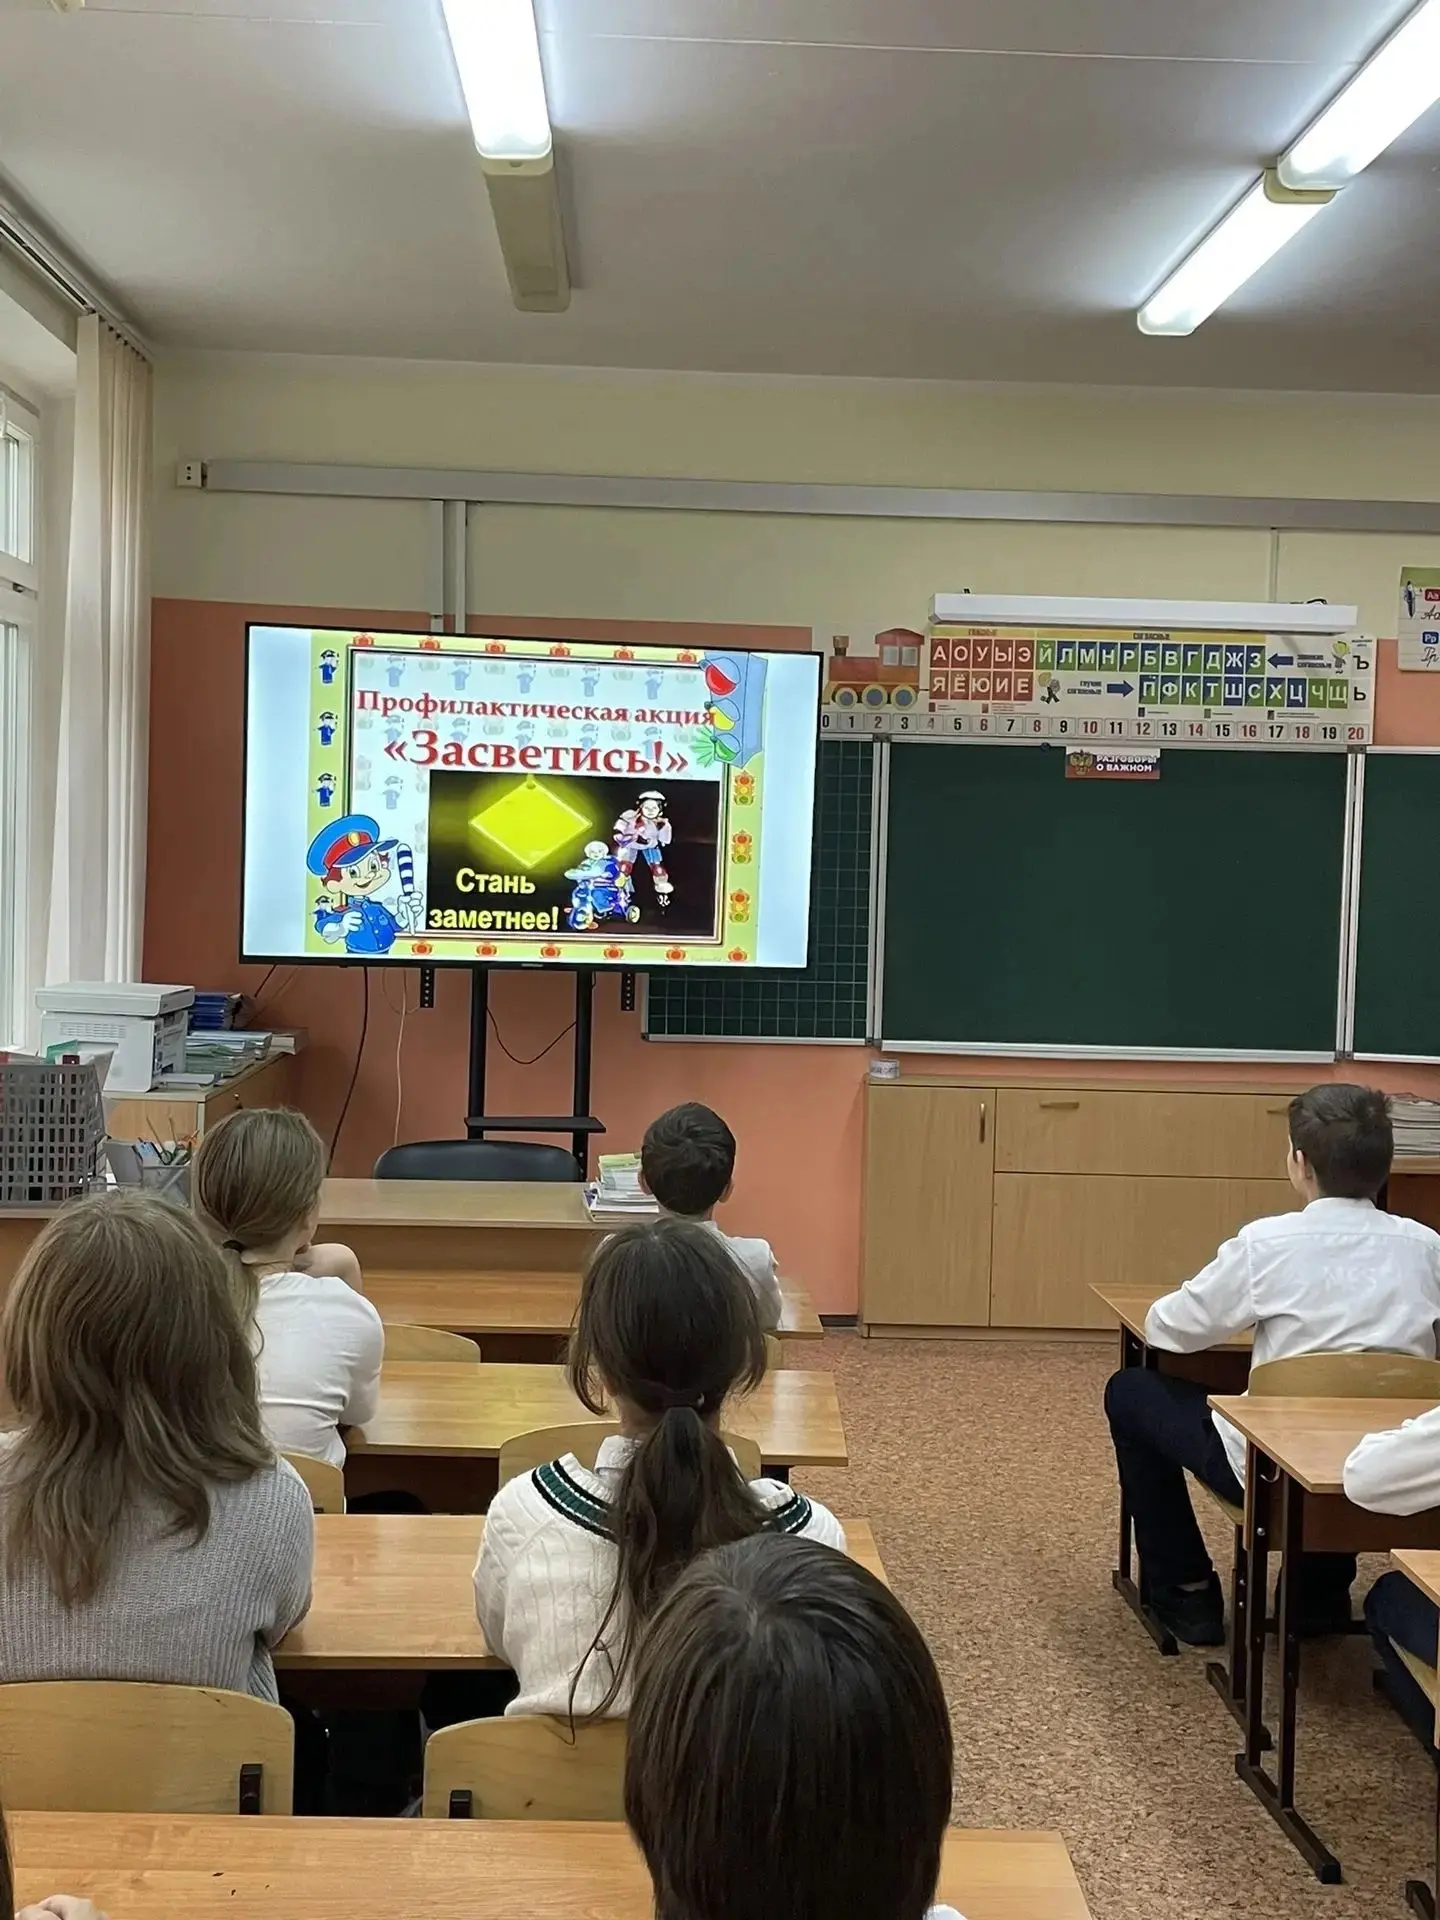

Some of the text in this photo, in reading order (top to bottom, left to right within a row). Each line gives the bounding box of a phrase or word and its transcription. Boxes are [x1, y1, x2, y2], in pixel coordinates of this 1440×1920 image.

[933, 645, 1031, 662] А О У Ы Э
[1039, 644, 1261, 670] Й Л М Н Р Б В Г Д Ж З
[1352, 655, 1370, 670] Ъ
[932, 674, 1029, 693] Я Ё Ю И Е
[1143, 681, 1347, 704] П Ф К Т Ш С Х Ц Ч Щ
[1353, 686, 1367, 701] Ь
[357, 689, 716, 727] Профилактическая акция
[822, 714, 1364, 740] 0 1 2 3 4 5 6 7 8 9 10 11 12 13 14 15 16 17 18 19 20
[384, 729, 689, 776] «Засветись!»
[1096, 755, 1157, 764] РАЗГОВОРЫ
[1096, 763, 1152, 772] О ВАЖНОМ
[455, 867, 536, 895] Стань
[428, 905, 560, 931] заметнее!
